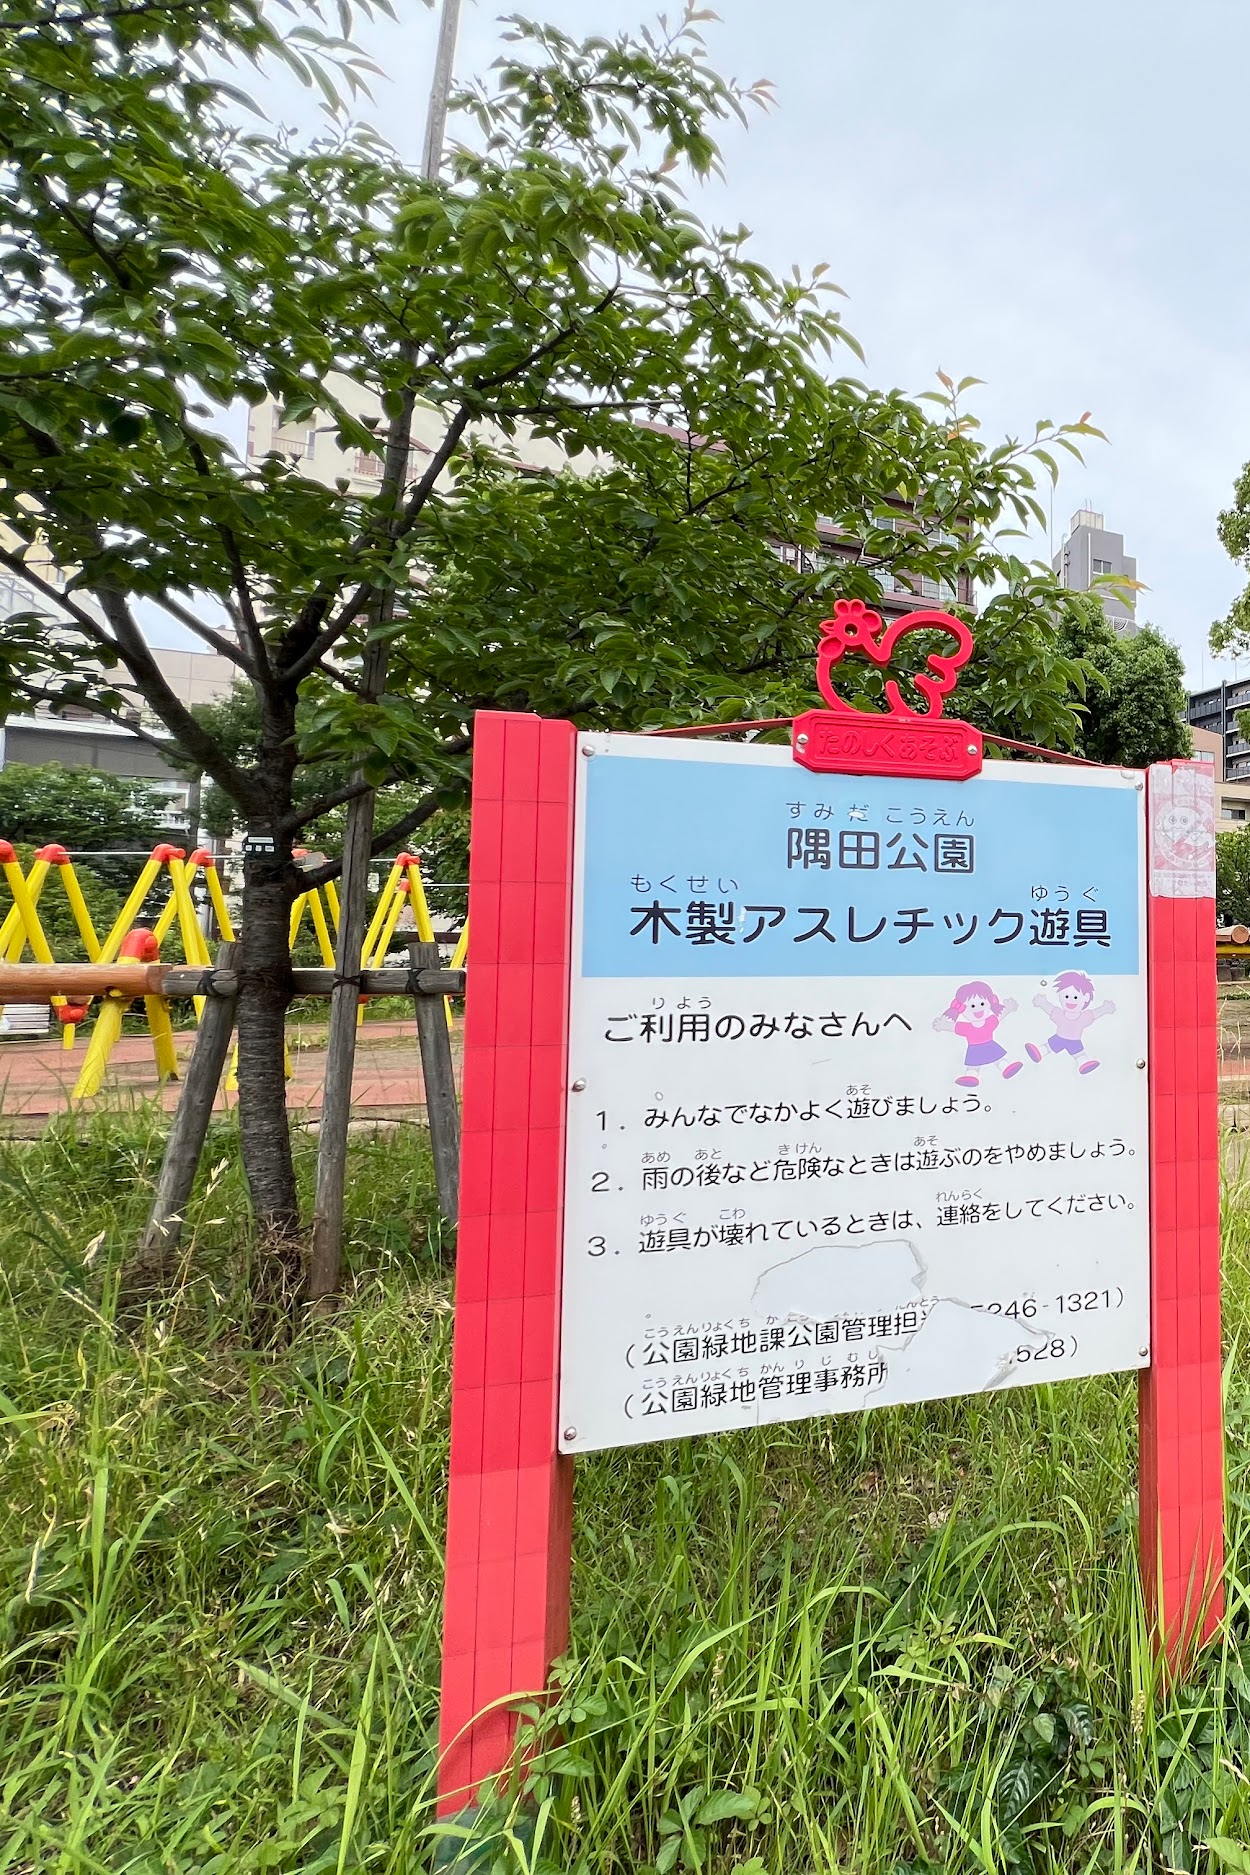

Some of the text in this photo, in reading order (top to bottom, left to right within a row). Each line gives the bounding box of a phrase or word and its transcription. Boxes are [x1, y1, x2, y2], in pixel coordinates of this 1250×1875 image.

[819, 727, 960, 762] たのしくあそぶ
[785, 801, 976, 828] すみだ こうえん
[786, 827, 975, 874] 隅田公園
[630, 873, 1100, 903] もくせい ゆうぐ
[629, 900, 1112, 948] 木製アスレチック遊具
[652, 996, 712, 1010] りよう
[604, 1010, 913, 1043] ご利用のみなさんへ
[845, 1083, 872, 1096] あそ
[643, 1093, 992, 1129] みんなでなかよく遊びましょう。
[641, 1135, 939, 1164] あめ あと きけん あそ
[641, 1138, 1136, 1191] 雨の後など危険なときは遊ぶのをやめましょう。
[638, 1193, 1135, 1254] 遊具が壊れているときは、連絡をしてください。
[640, 1187, 983, 1226] ゆうぐ こわ れんらく
[971, 1286, 1124, 1320] 246-1321）
